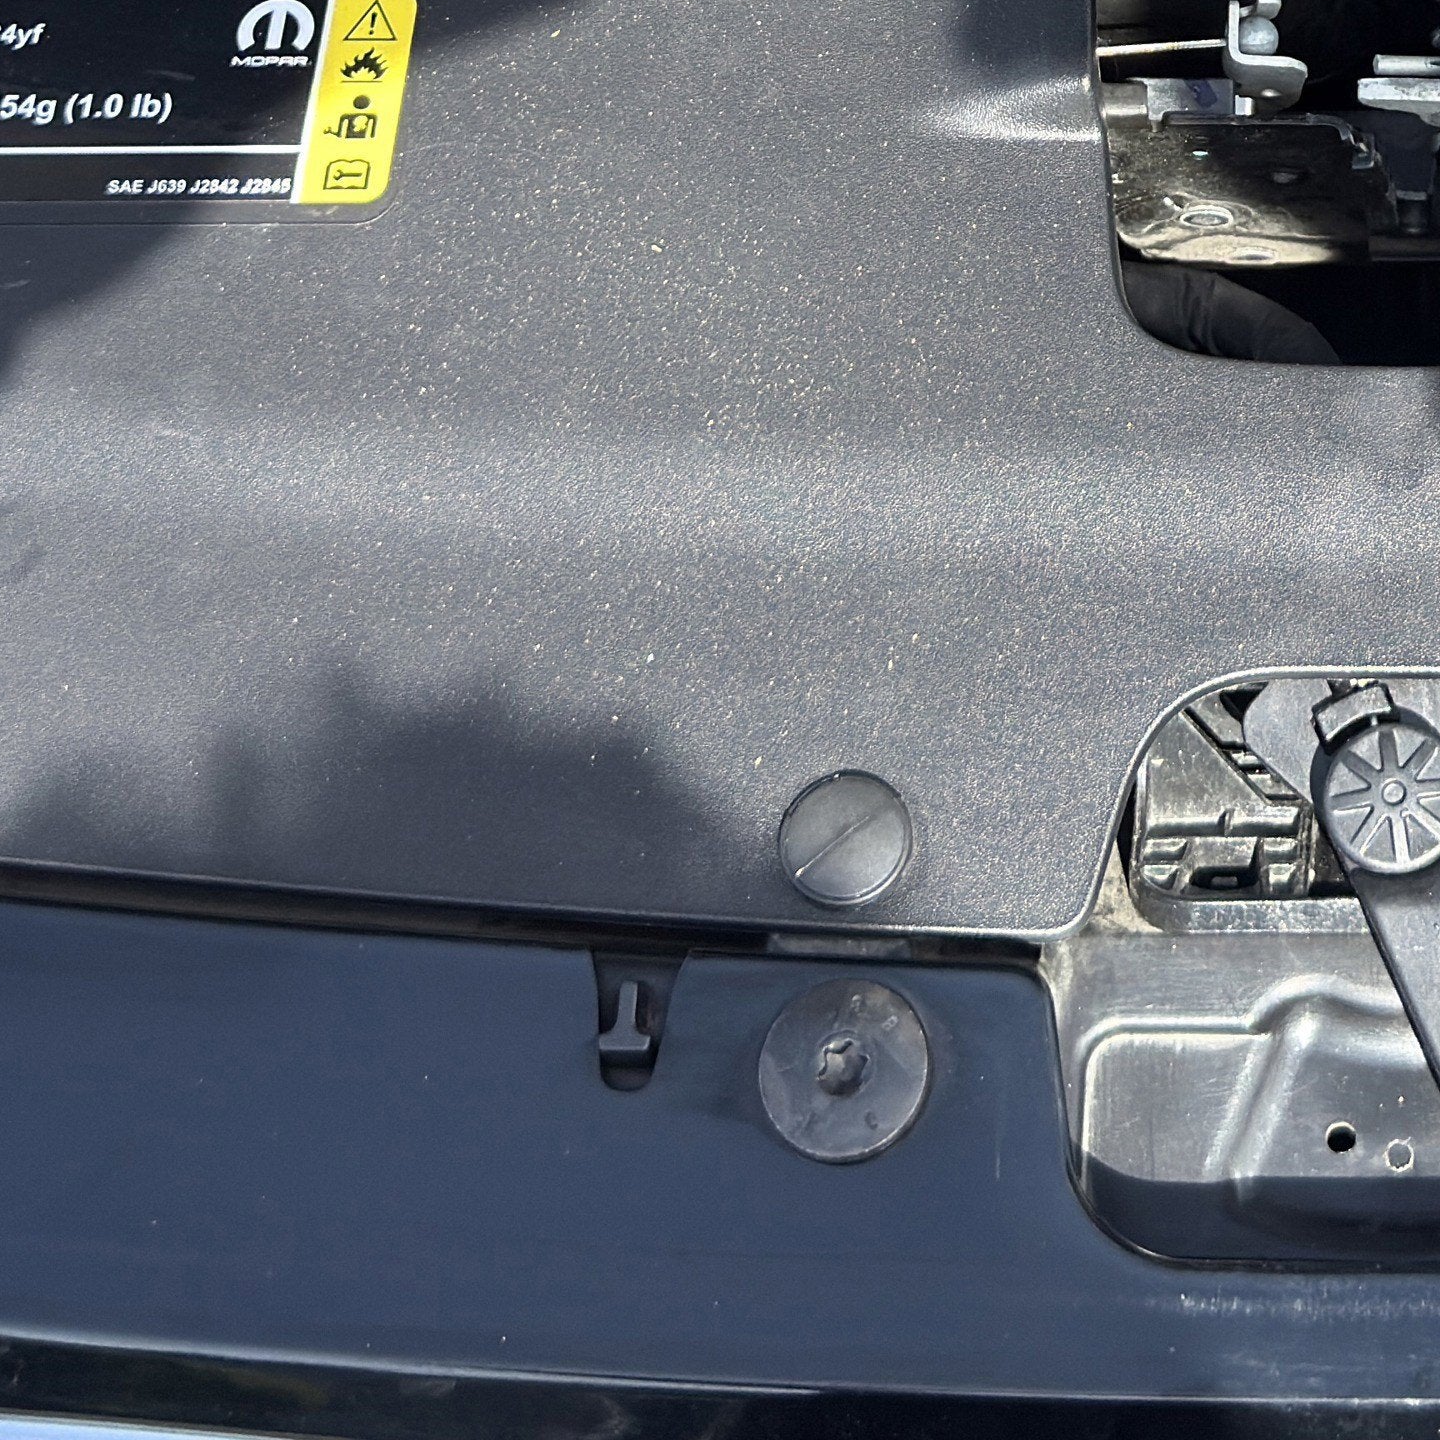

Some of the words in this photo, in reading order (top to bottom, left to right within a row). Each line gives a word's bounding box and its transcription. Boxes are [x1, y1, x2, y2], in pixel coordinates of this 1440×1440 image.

[229, 55, 312, 68] MOPAR
[63, 92, 124, 125] (1.0
[129, 91, 174, 124] lb)
[106, 178, 145, 195] SAE
[146, 178, 188, 195] J639
